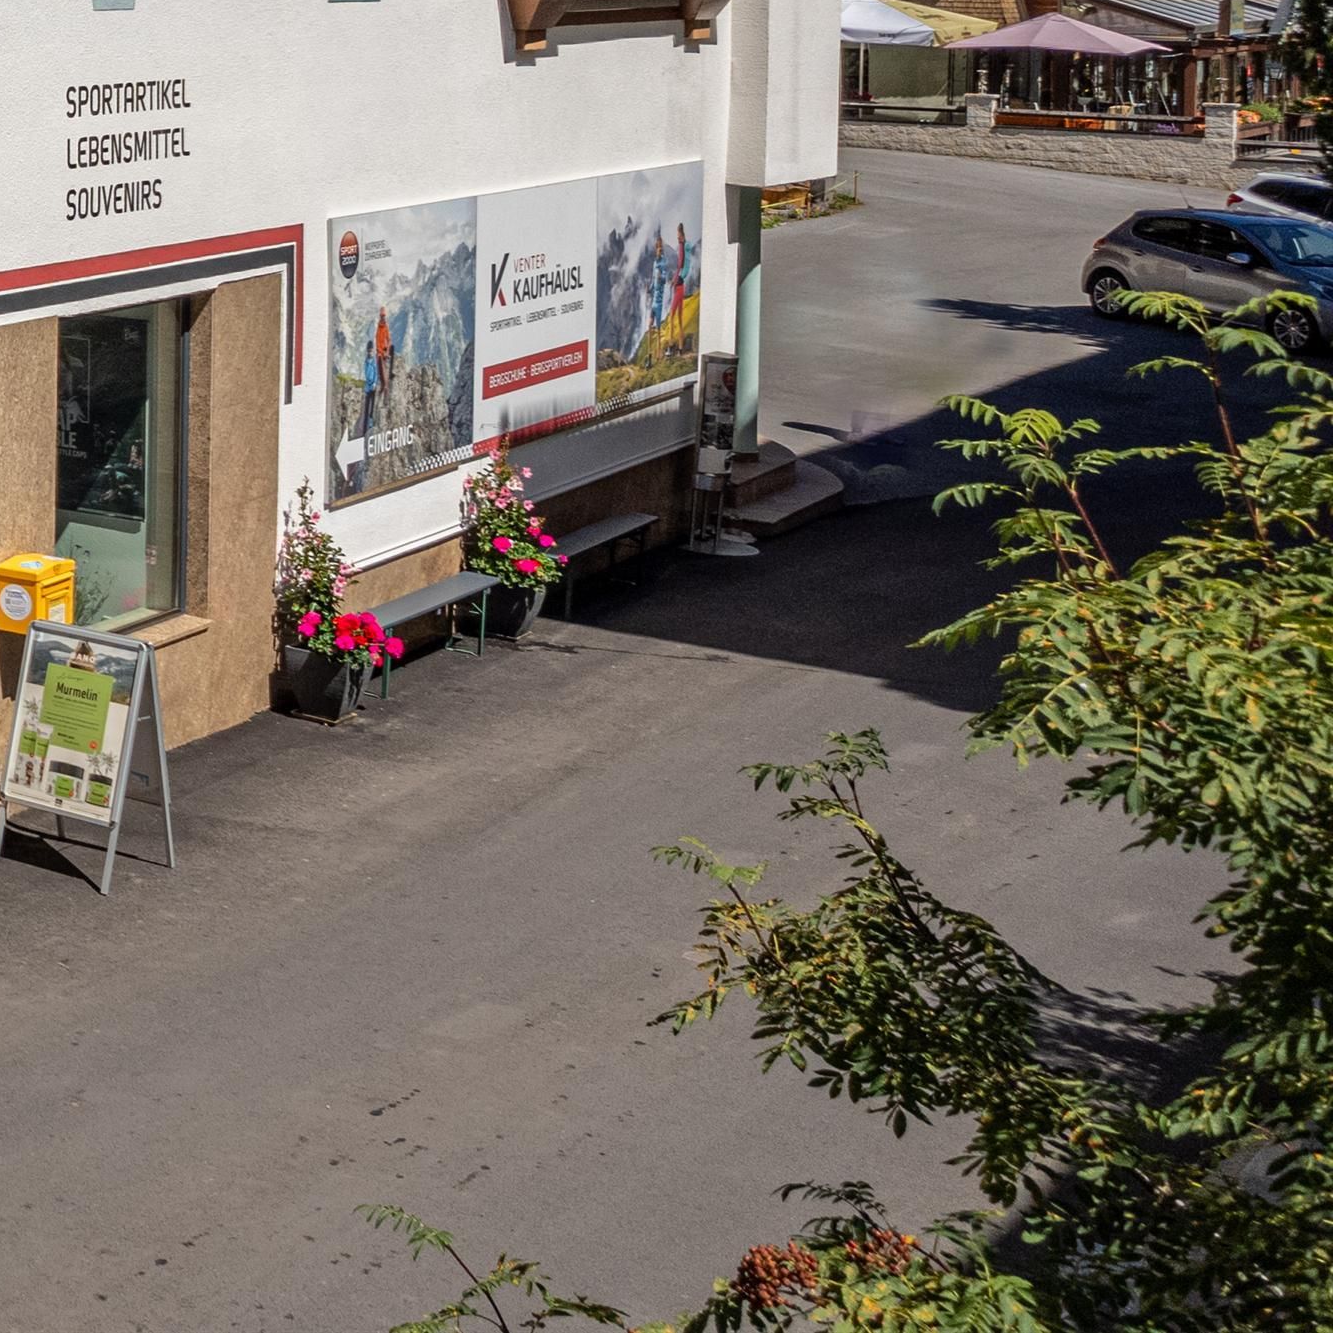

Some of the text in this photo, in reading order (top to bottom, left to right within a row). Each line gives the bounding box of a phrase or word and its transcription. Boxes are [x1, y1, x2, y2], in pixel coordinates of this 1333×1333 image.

[66, 78, 191, 118] SPORTARTIKEL
[66, 127, 191, 169] LEBENSMITTEL
[66, 178, 162, 221] SOUVENIRS
[340, 244, 358, 256] SPORT
[513, 253, 546, 273] VENTER
[513, 263, 584, 304] KAUFHÄUSL
[367, 424, 414, 456] EINGANG
[55, 681, 99, 702] Murmelin
